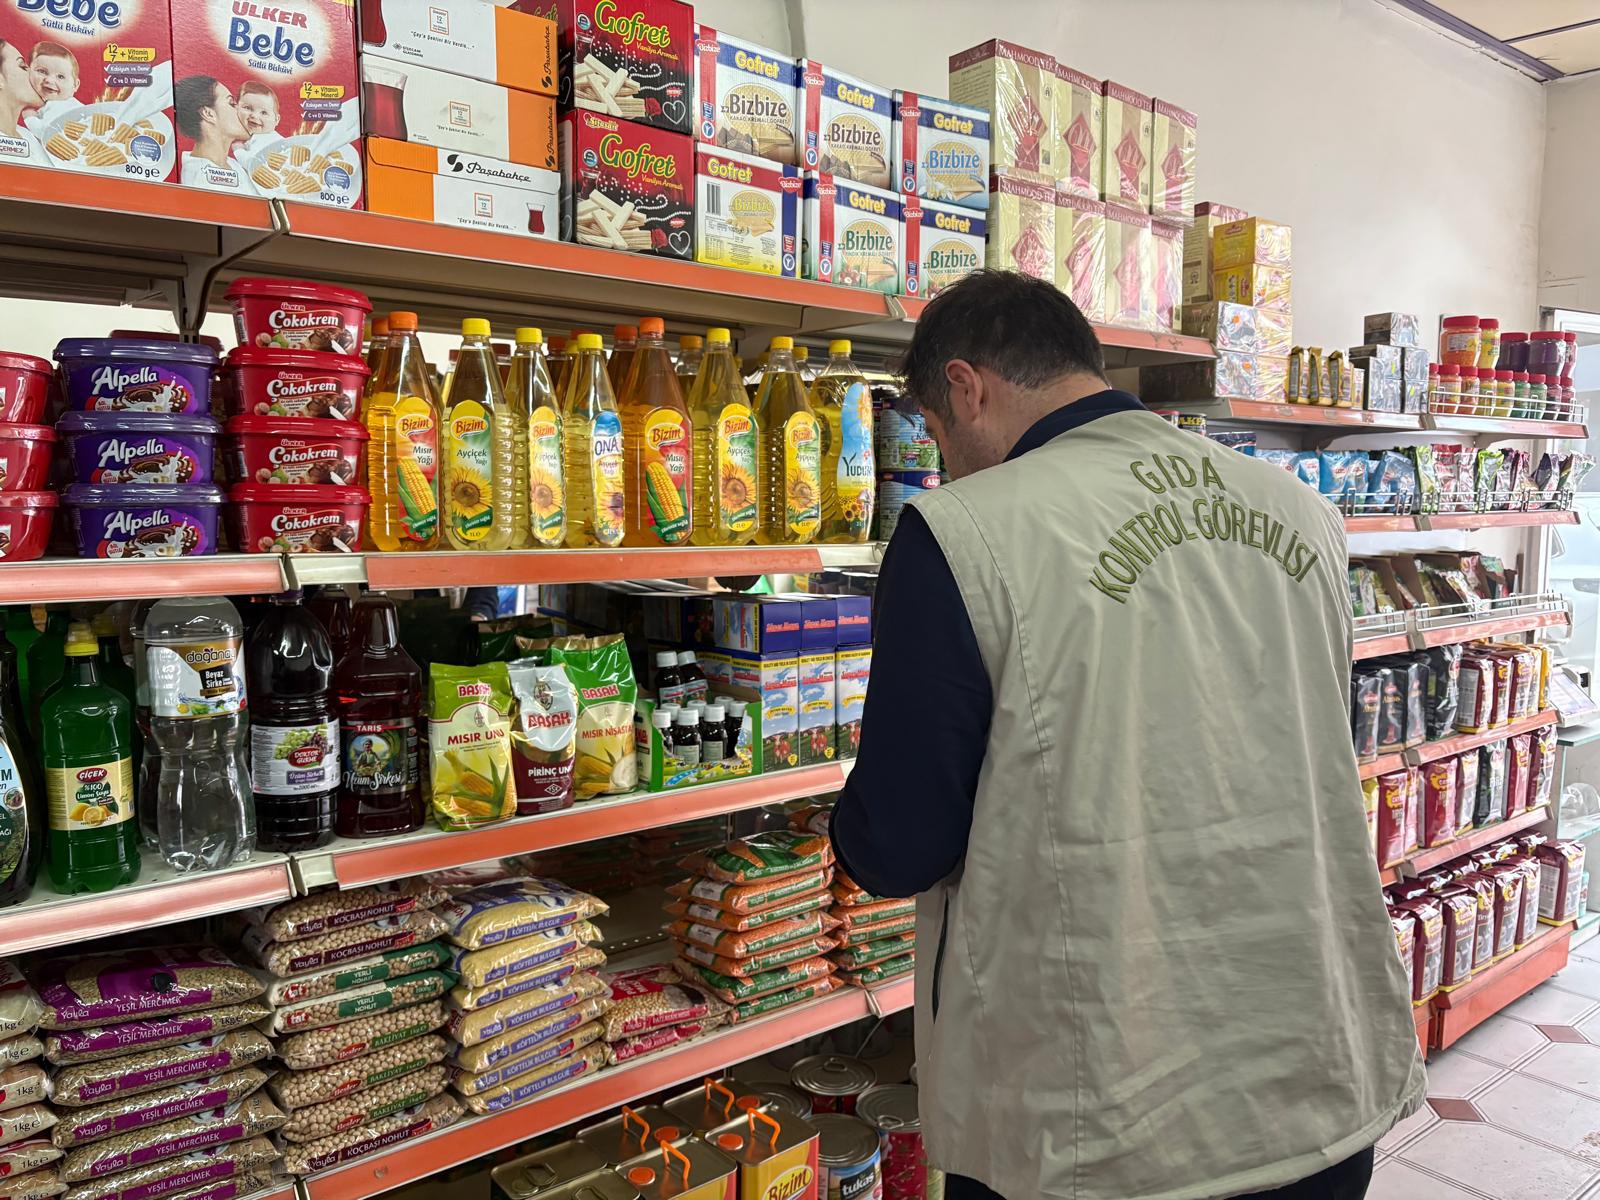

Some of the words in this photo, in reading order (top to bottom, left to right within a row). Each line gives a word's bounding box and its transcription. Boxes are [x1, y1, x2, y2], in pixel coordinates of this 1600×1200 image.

[42, 18, 63, 31] Sütlü
[66, 23, 95, 36] Bisküvi
[595, 0, 670, 48] Gofret
[108, 45, 118, 54] 12
[227, 16, 315, 66] Bebe
[248, 59, 266, 71] Sütlü
[267, 62, 293, 75] Bisküvi
[735, 51, 779, 79] Gofret
[304, 83, 312, 92] 12
[837, 83, 875, 110] Gofret
[729, 93, 787, 118] Bizbize
[934, 113, 974, 134] Gofret
[831, 123, 881, 146] Bizbize
[600, 133, 676, 178] Gofret
[929, 149, 980, 169] Bizbize
[125, 164, 143, 175] 800
[465, 161, 532, 183] Paşabahçe
[707, 158, 753, 183] Gofret
[320, 191, 335, 202] 800
[849, 191, 886, 214] Gofret
[935, 212, 971, 234] Gofret
[845, 229, 893, 251] Bizbize
[930, 249, 977, 269] Bizbize
[268, 310, 339, 333] Çokokrem
[92, 366, 157, 396] Alpella
[266, 379, 337, 403] Çokokrem
[401, 418, 430, 432] Bizim
[455, 419, 485, 434] Bizim
[533, 425, 555, 437] Bizim
[724, 420, 749, 434] Bizim
[652, 427, 681, 442] Bizim
[98, 438, 164, 467] Alpella
[412, 446, 433, 454] Mısır
[456, 449, 487, 460] Ayçiçek
[594, 440, 620, 456] ONA
[268, 446, 338, 469] Çokokrem
[417, 456, 433, 466] Yağı
[1129, 453, 1227, 495] GIDA
[104, 509, 170, 539] Alpella
[271, 514, 340, 536] Çokokrem
[1088, 500, 1198, 605] KONTROL
[205, 670, 224, 681] Beyaz
[206, 680, 222, 688] Sirke
[448, 732, 482, 746] MISIR
[484, 728, 505, 740] UNU
[581, 728, 605, 740] MISIR
[79, 768, 106, 780] ÇİÇEK
[528, 766, 557, 778] PİRİNÇ
[77, 792, 95, 800] Limon
[300, 921, 323, 932] Yayla
[367, 904, 395, 917] NOHUT
[294, 956, 319, 969] Yayla
[365, 938, 393, 951] NOHUT
[539, 949, 561, 962] BULGUR
[353, 969, 372, 978] YERLİ
[60, 1005, 90, 1020] Yayla
[354, 1002, 377, 1013] NOHUT
[538, 1001, 562, 1015] BULGUR
[0, 1020, 17, 1032] 1kg
[4, 1048, 19, 1060] 1kg
[83, 1081, 112, 1098] Yayla
[143, 1069, 165, 1082] YEŞİL
[165, 1060, 209, 1078] MERCİMEK
[547, 1069, 570, 1085] BULGUR
[16, 1086, 34, 1097] 1kg
[13, 1121, 31, 1133] 1kg
[79, 1122, 108, 1137] Yayla
[140, 1110, 162, 1123] YEŞİL
[162, 1099, 205, 1117] MERCİMEK
[94, 1157, 124, 1173] Yayla
[156, 1143, 177, 1156] YEŞİL
[177, 1132, 220, 1150] MERCİMEK
[312, 1156, 336, 1168] Yayla
[346, 1139, 381, 1158] KOÇBAŞI
[381, 1129, 410, 1144] NOHUT
[21, 1159, 39, 1170] 1kg
[146, 1181, 168, 1195] YEŞİL
[168, 1170, 211, 1189] MERCİMEK
[767, 1168, 810, 1200] Bizim
